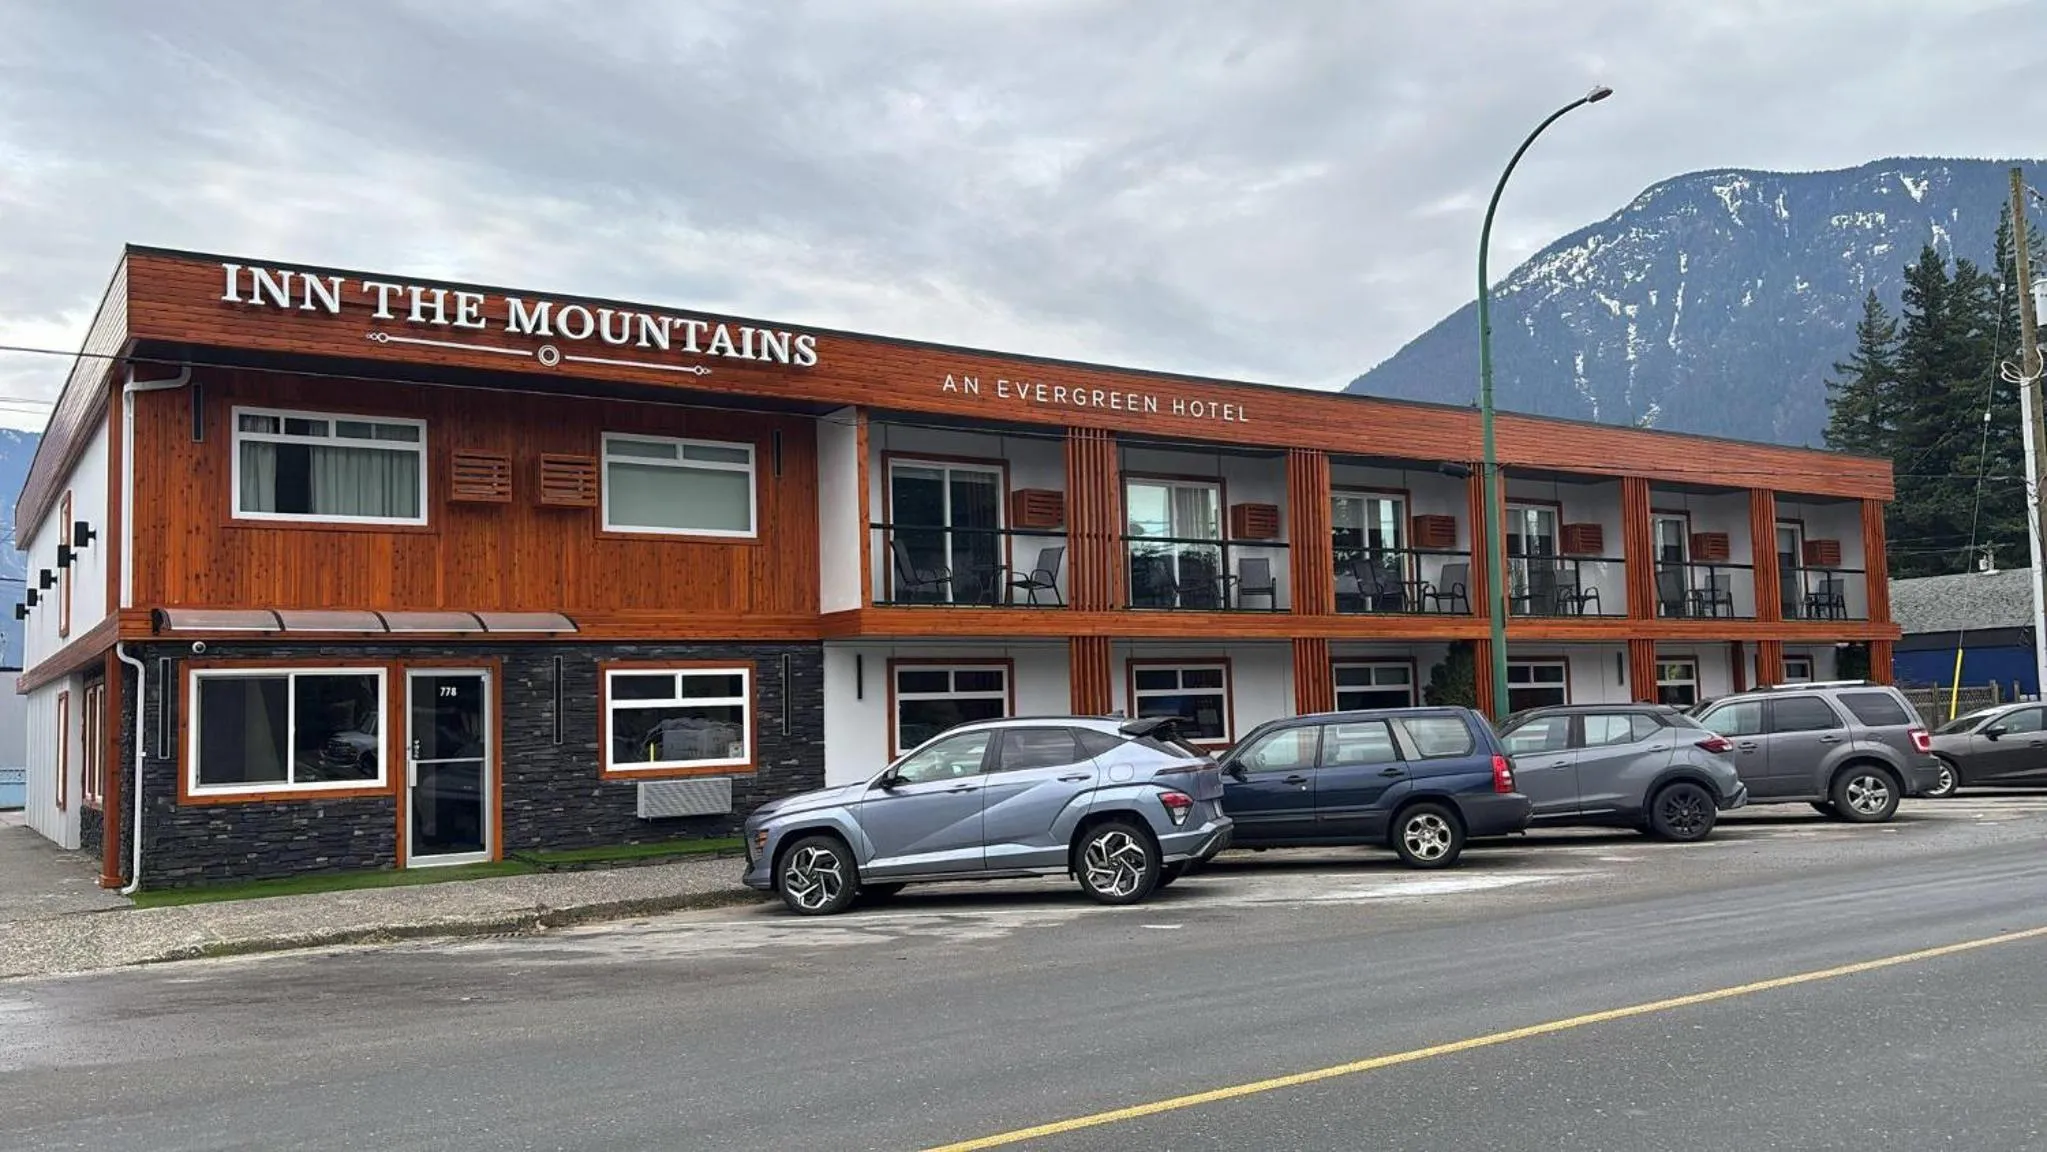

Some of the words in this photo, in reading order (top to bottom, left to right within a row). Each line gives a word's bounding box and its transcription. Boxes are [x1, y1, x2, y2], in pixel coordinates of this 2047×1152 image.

[221, 263, 345, 314] INN
[362, 281, 486, 329] THE
[504, 296, 818, 367] MOUNTAINS
[942, 374, 979, 395] AN
[998, 379, 1158, 413] EVERGREEN
[1173, 398, 1249, 423] HOTEL
[440, 686, 457, 697] 778
